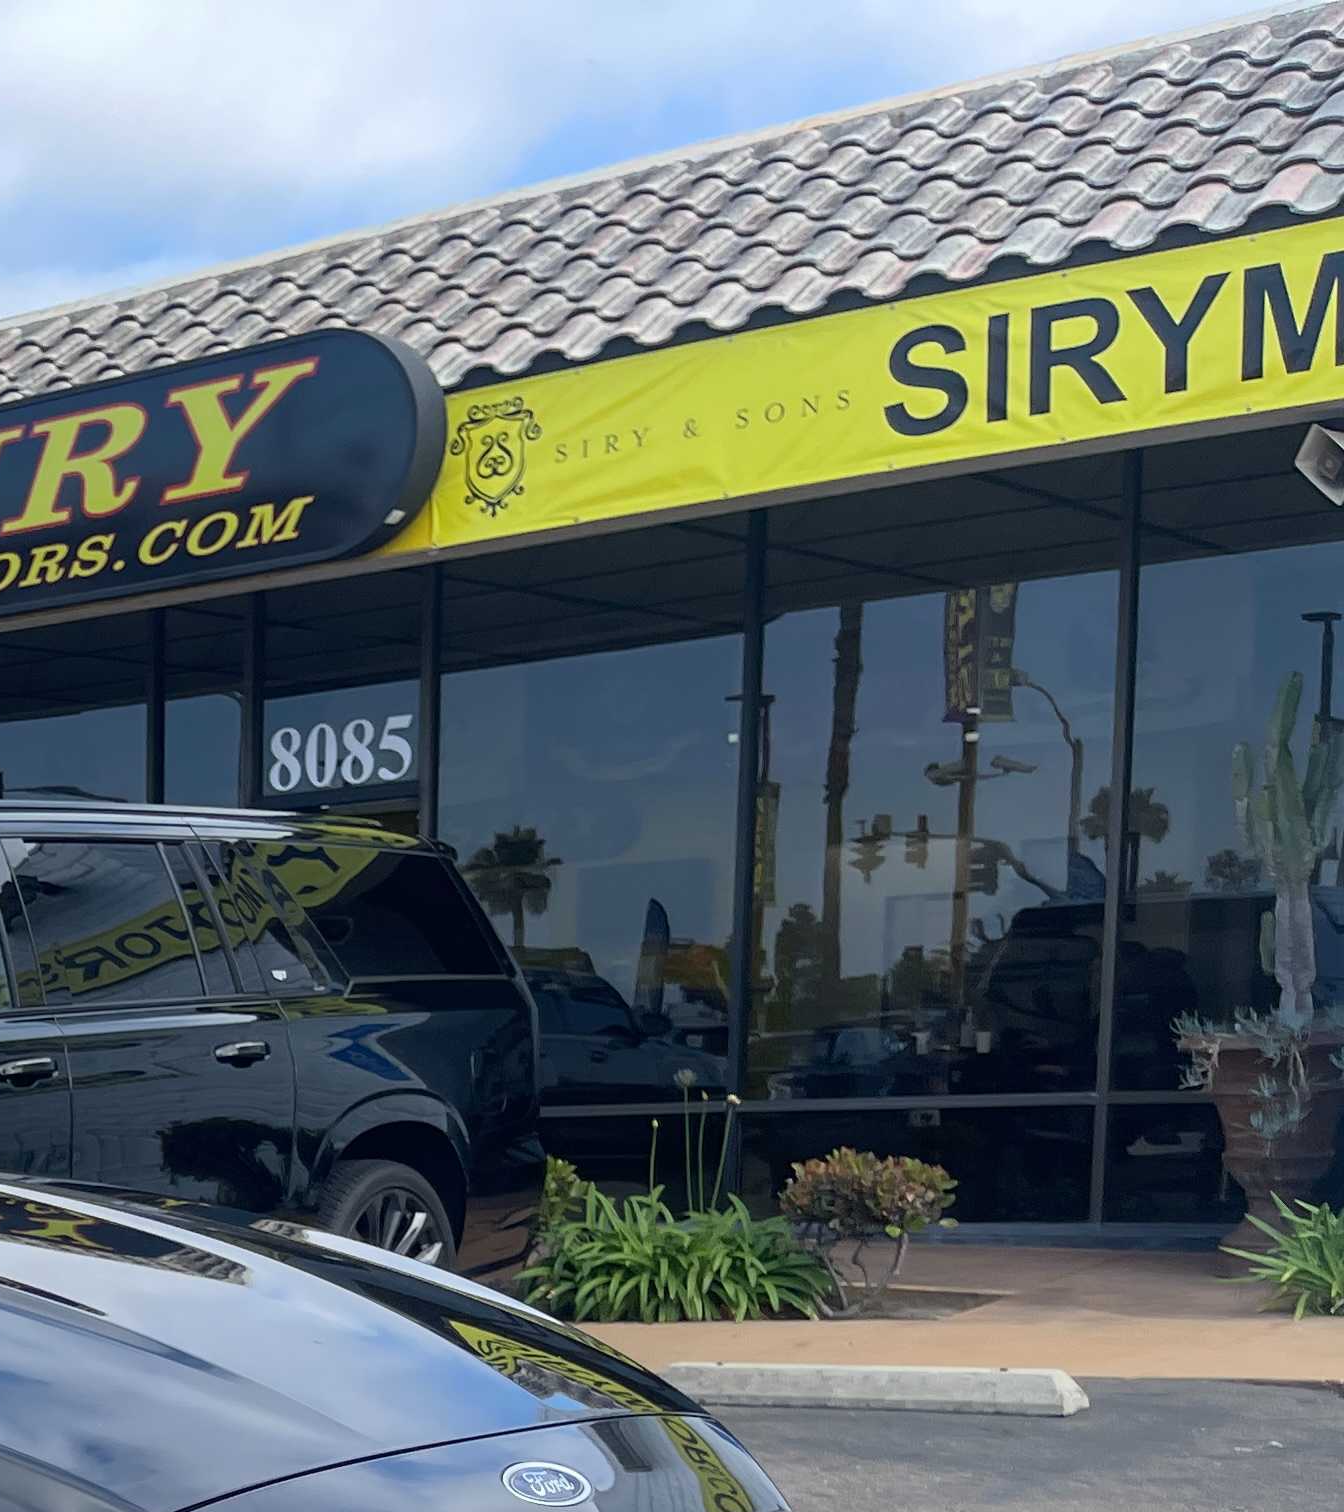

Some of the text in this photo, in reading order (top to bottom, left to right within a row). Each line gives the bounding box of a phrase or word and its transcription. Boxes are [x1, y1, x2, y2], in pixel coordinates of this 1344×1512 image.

[554, 388, 853, 464] SIRY & SONS
[268, 713, 414, 792] 8085
[522, 1469, 576, 1497] Ford
